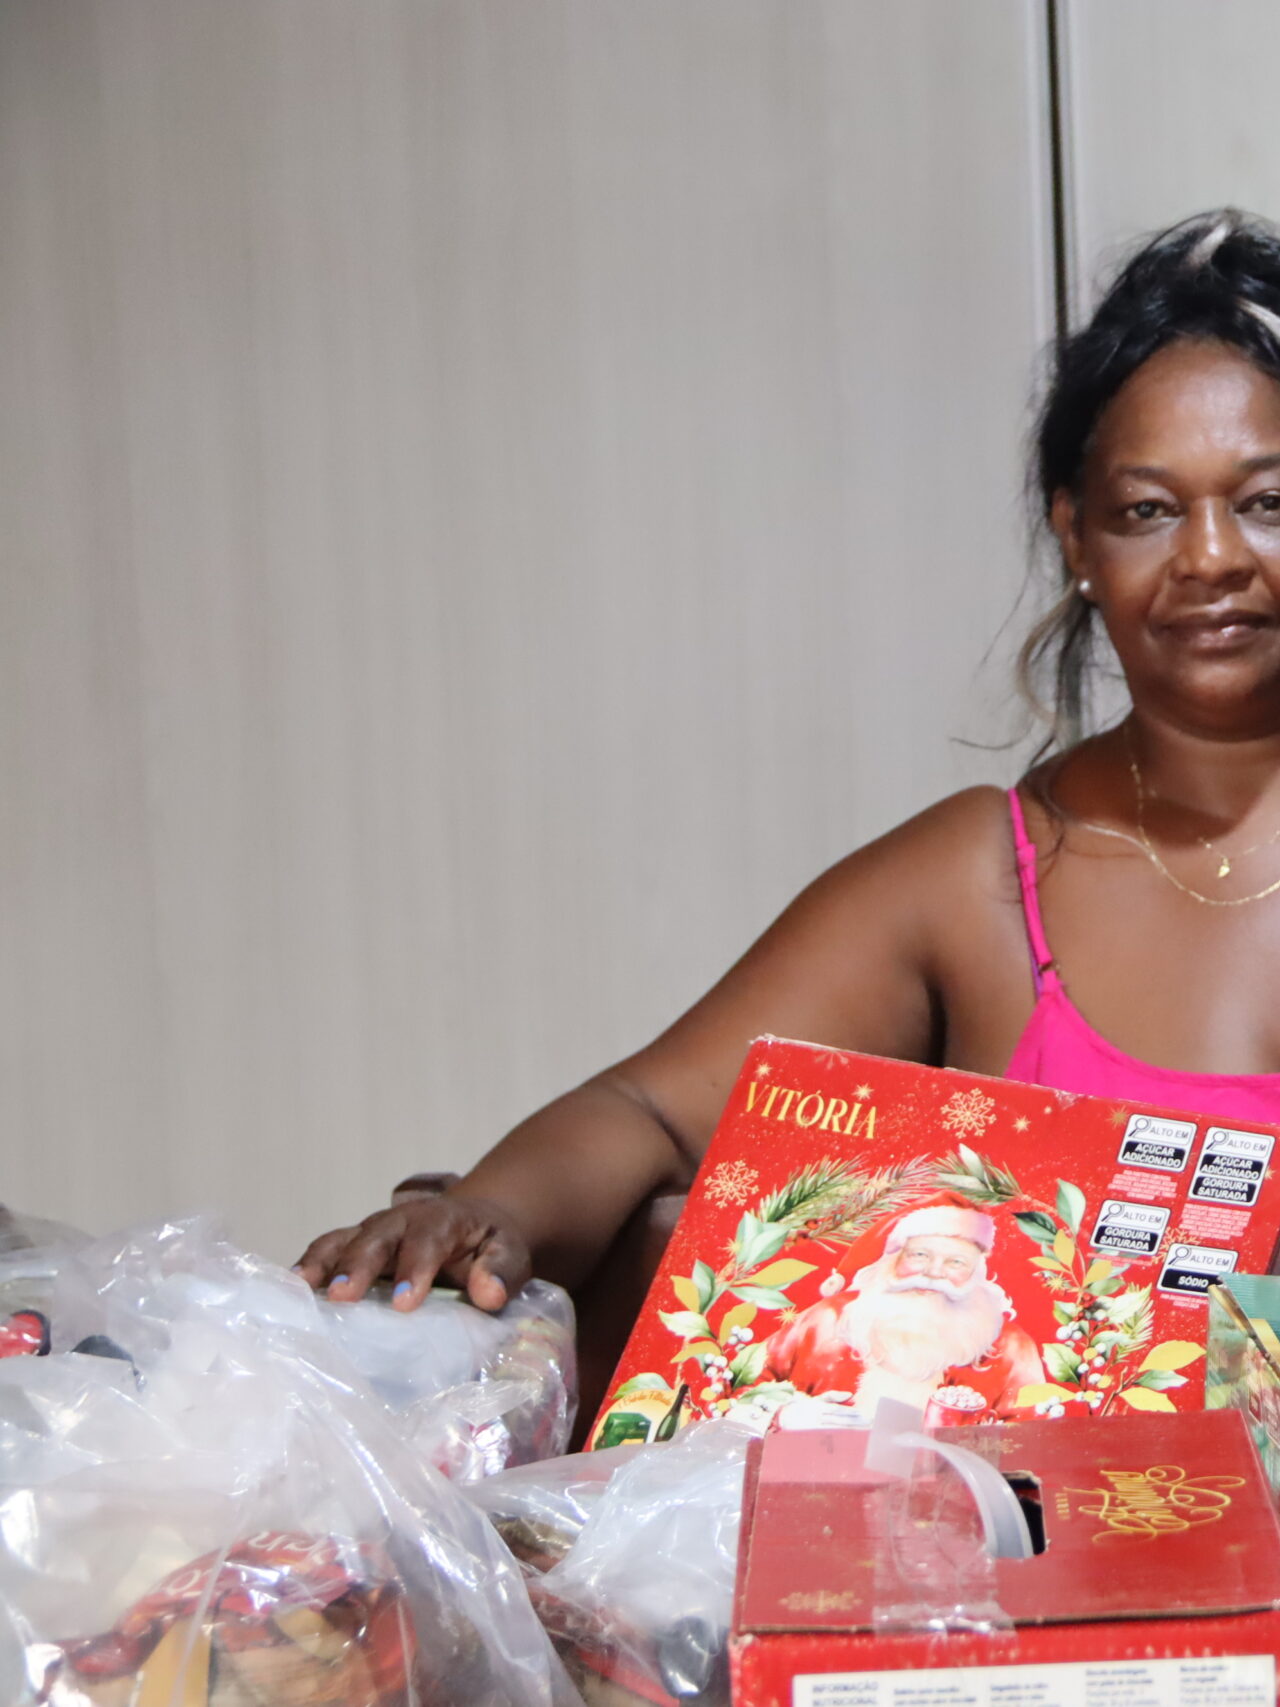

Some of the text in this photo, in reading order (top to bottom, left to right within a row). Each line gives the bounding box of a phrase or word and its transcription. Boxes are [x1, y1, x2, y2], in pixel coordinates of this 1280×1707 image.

[745, 1081, 877, 1140] VITÓRIA
[1150, 1125, 1189, 1139] ALTO EM
[1227, 1138, 1267, 1152] ALTO EM
[1123, 1151, 1182, 1168] ADICIONADO
[1200, 1164, 1260, 1180] ADICIONADO
[1202, 1177, 1249, 1192] GORDURA
[1197, 1186, 1247, 1201] SATURADA
[1122, 1210, 1163, 1224] ALTO EM
[1104, 1226, 1151, 1241] GORDURA
[1100, 1235, 1150, 1251] SATURADA
[1190, 1254, 1230, 1267] ALTO EM
[1178, 1274, 1209, 1288] SÓDIO
